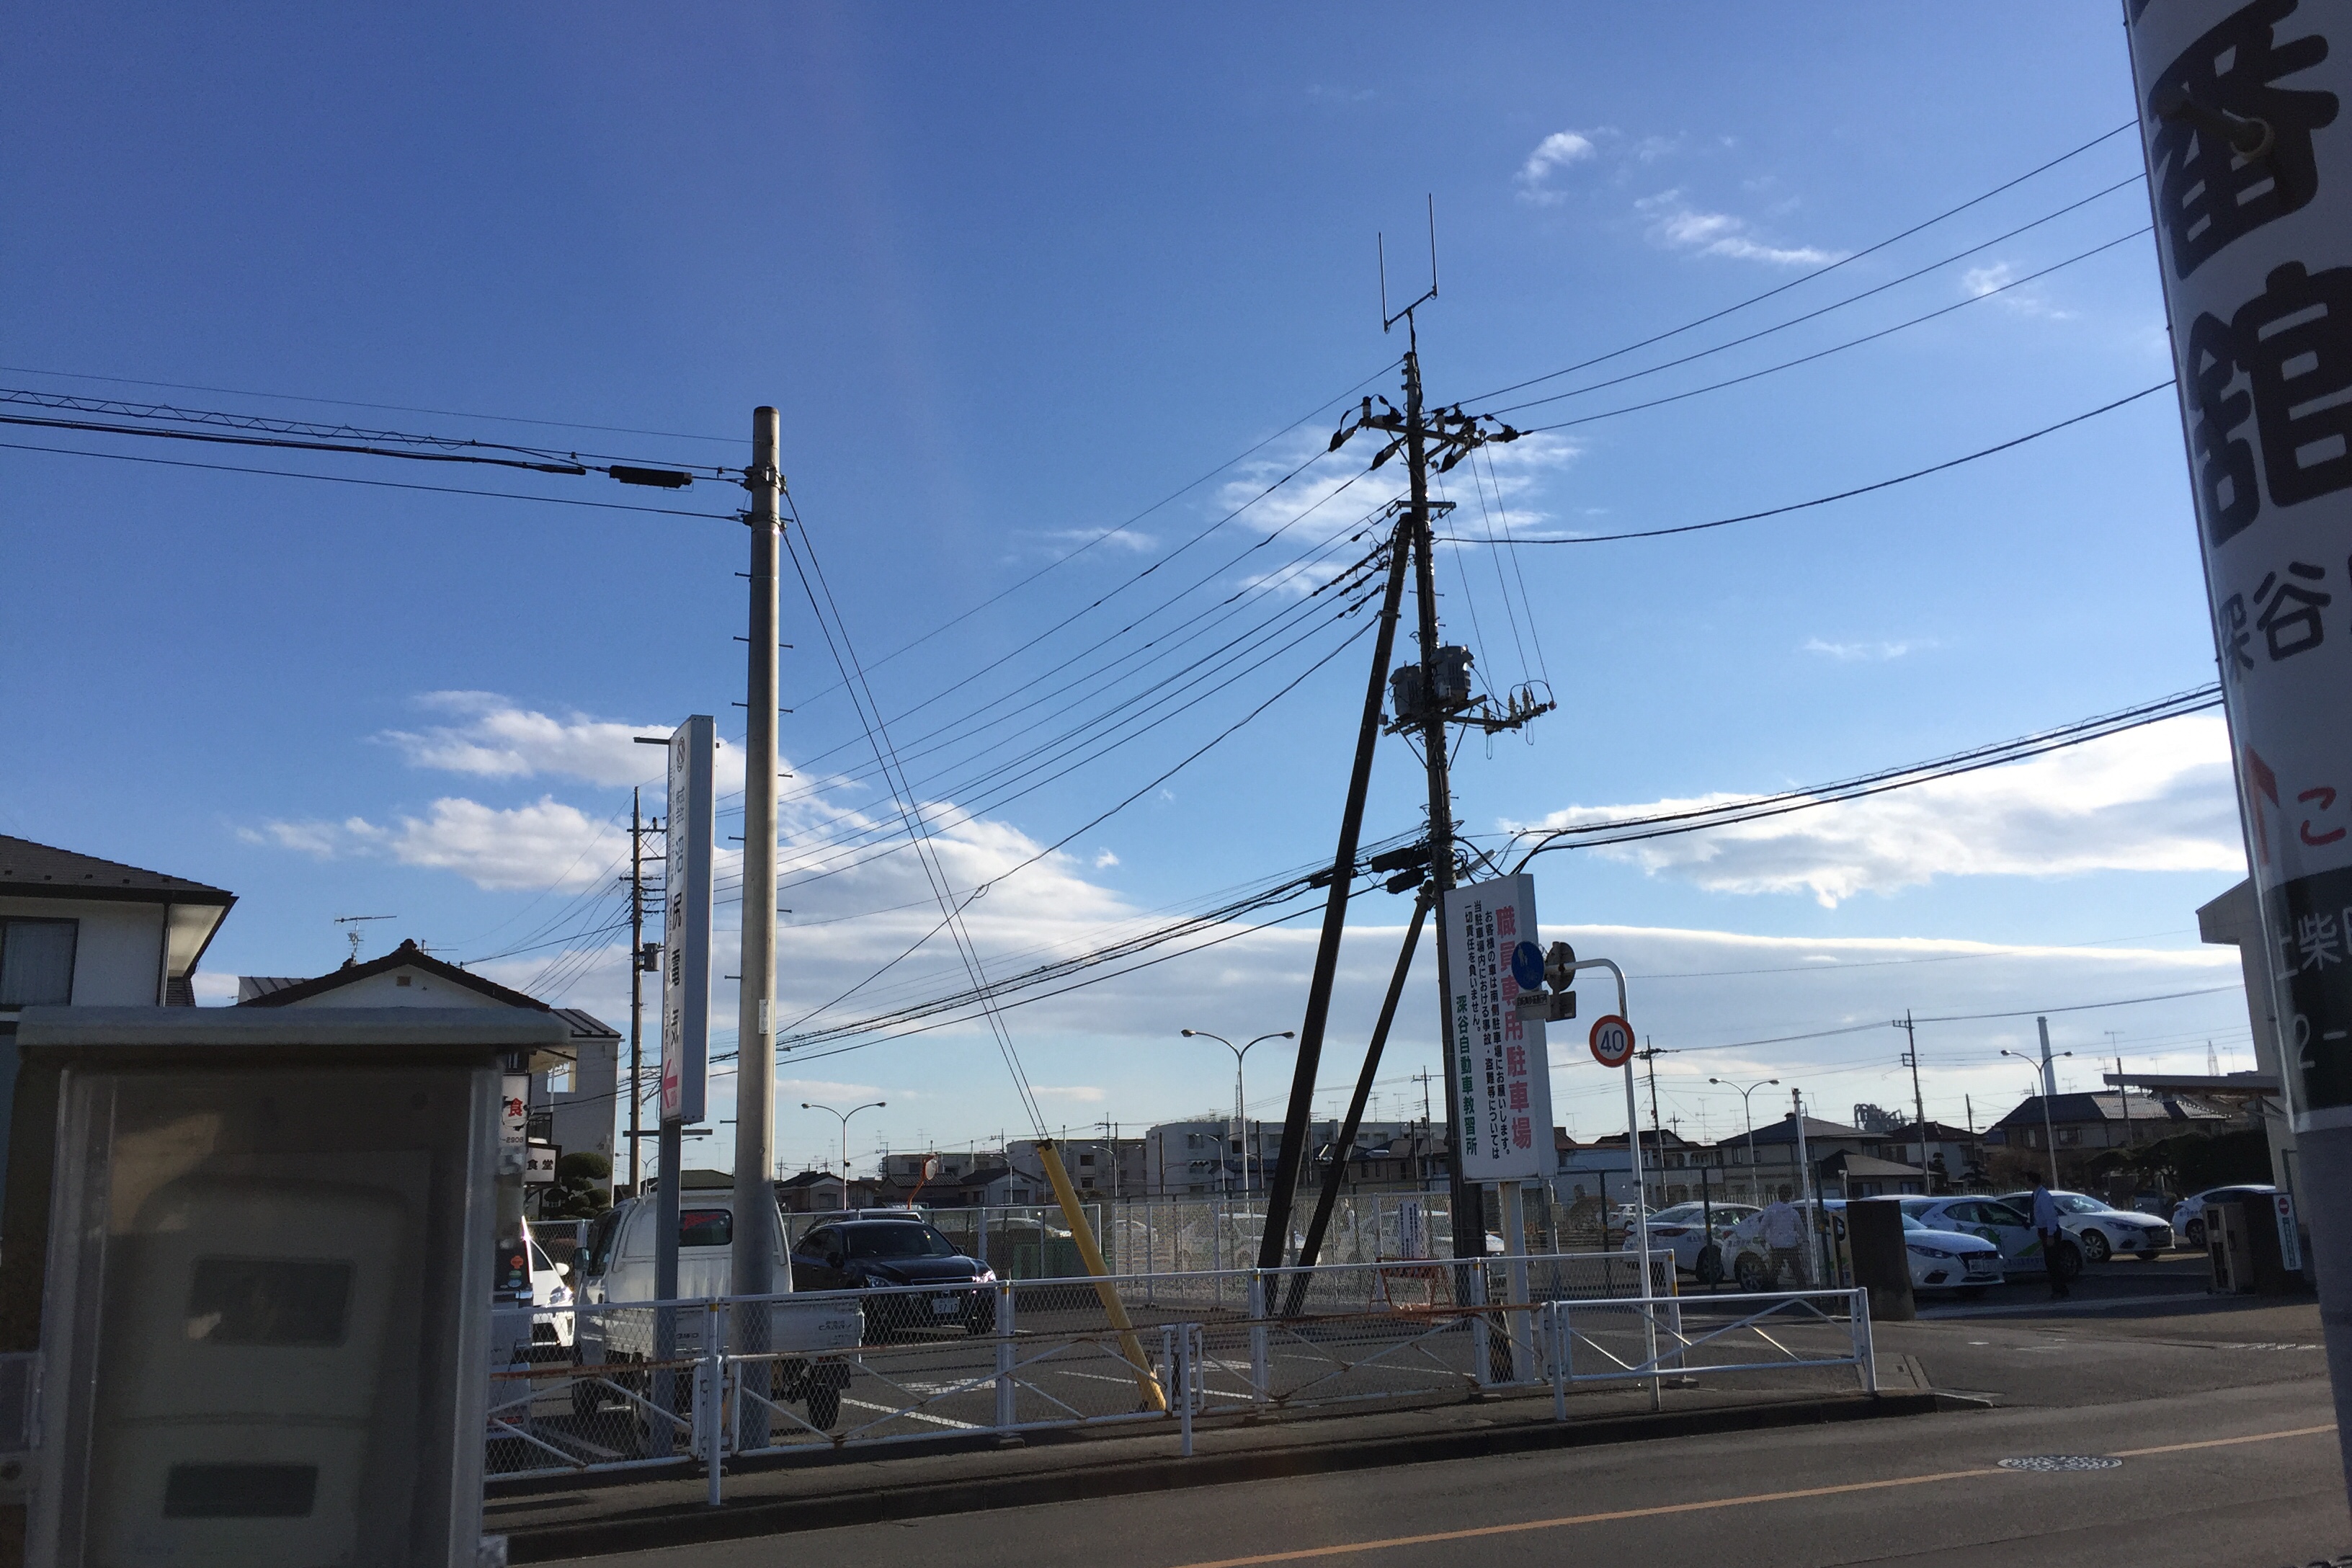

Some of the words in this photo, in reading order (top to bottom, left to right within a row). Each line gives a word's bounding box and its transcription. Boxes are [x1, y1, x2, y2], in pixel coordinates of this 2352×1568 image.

[2219, 554, 2352, 682] 深谷
[2297, 786, 2352, 847] こ
[1464, 905, 1481, 1032] 一切責任を負いません。
[2275, 904, 2352, 981] 上柴
[1456, 994, 1477, 1156] 深谷自動車教習所
[1474, 900, 1500, 1159] 当駐車場内における事故・盗難等については
[1485, 910, 1510, 1155] お客様の車は南側駐車場にお願いします。
[1495, 905, 1532, 1149] 職員専用駐車場
[1600, 1030, 1624, 1052] 40
[508, 1097, 523, 1117] 食
[527, 1159, 553, 1170] 食堂
